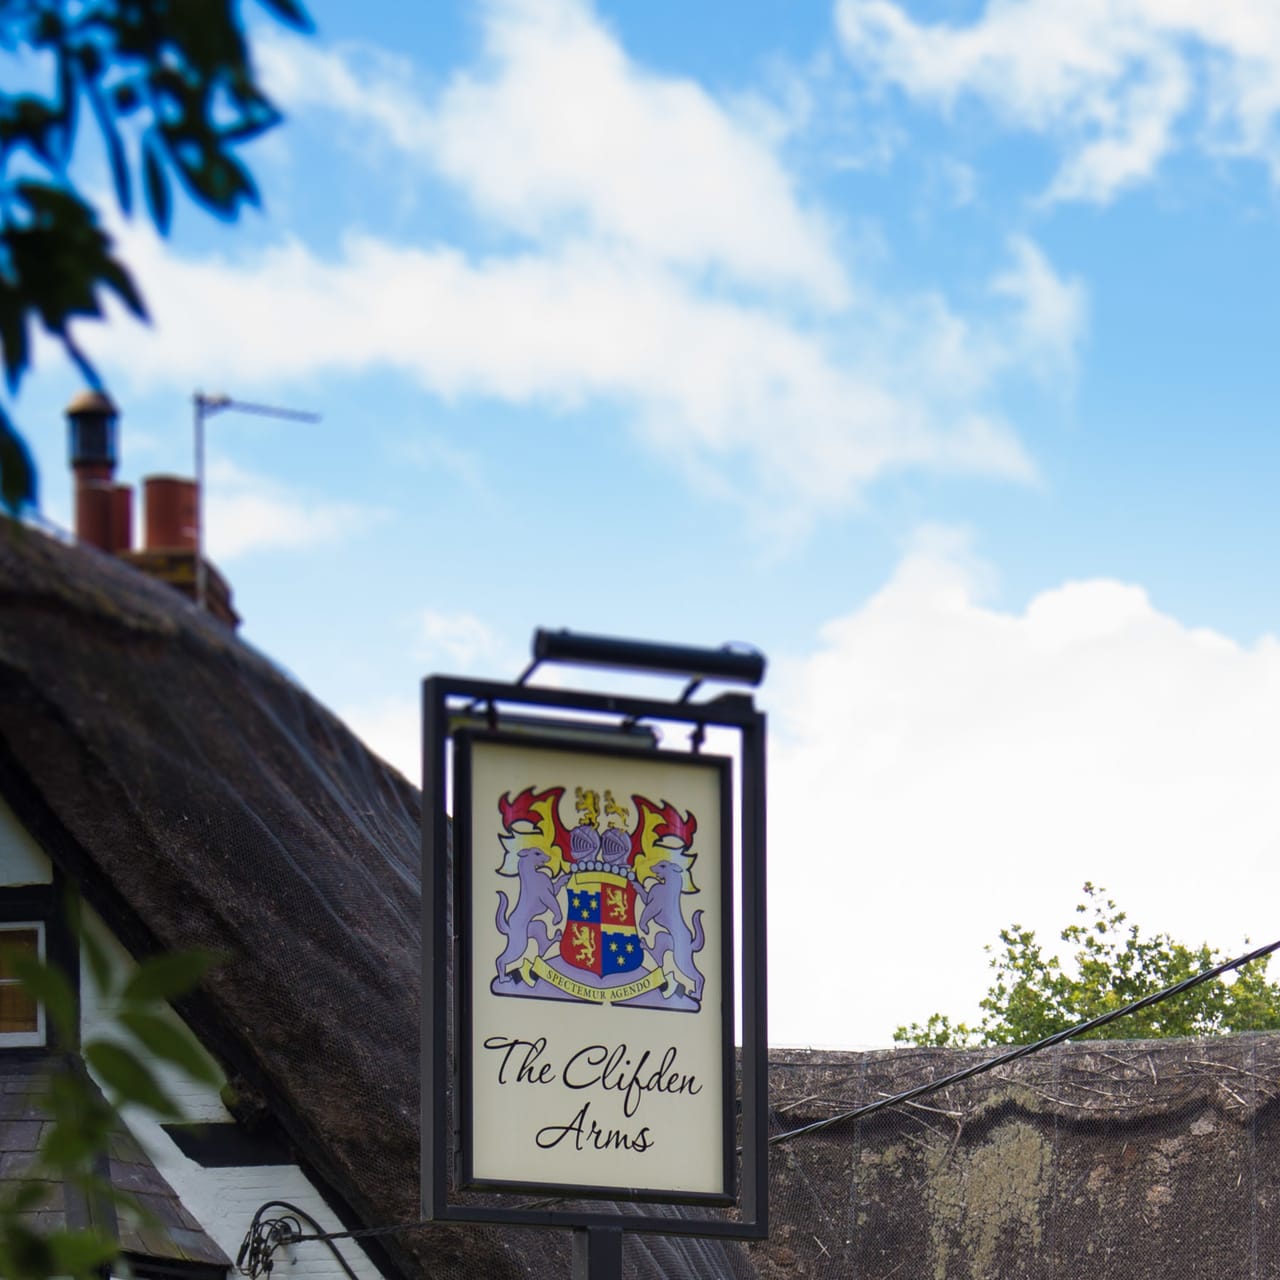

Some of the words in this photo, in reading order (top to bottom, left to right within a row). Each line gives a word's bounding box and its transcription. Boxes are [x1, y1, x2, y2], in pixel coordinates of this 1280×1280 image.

[546, 970, 606, 999] SPECTEMUR
[610, 979, 651, 999] AGENDO
[483, 1036, 556, 1085] The
[562, 1043, 703, 1118] Clifden
[535, 1101, 655, 1153] Arms
